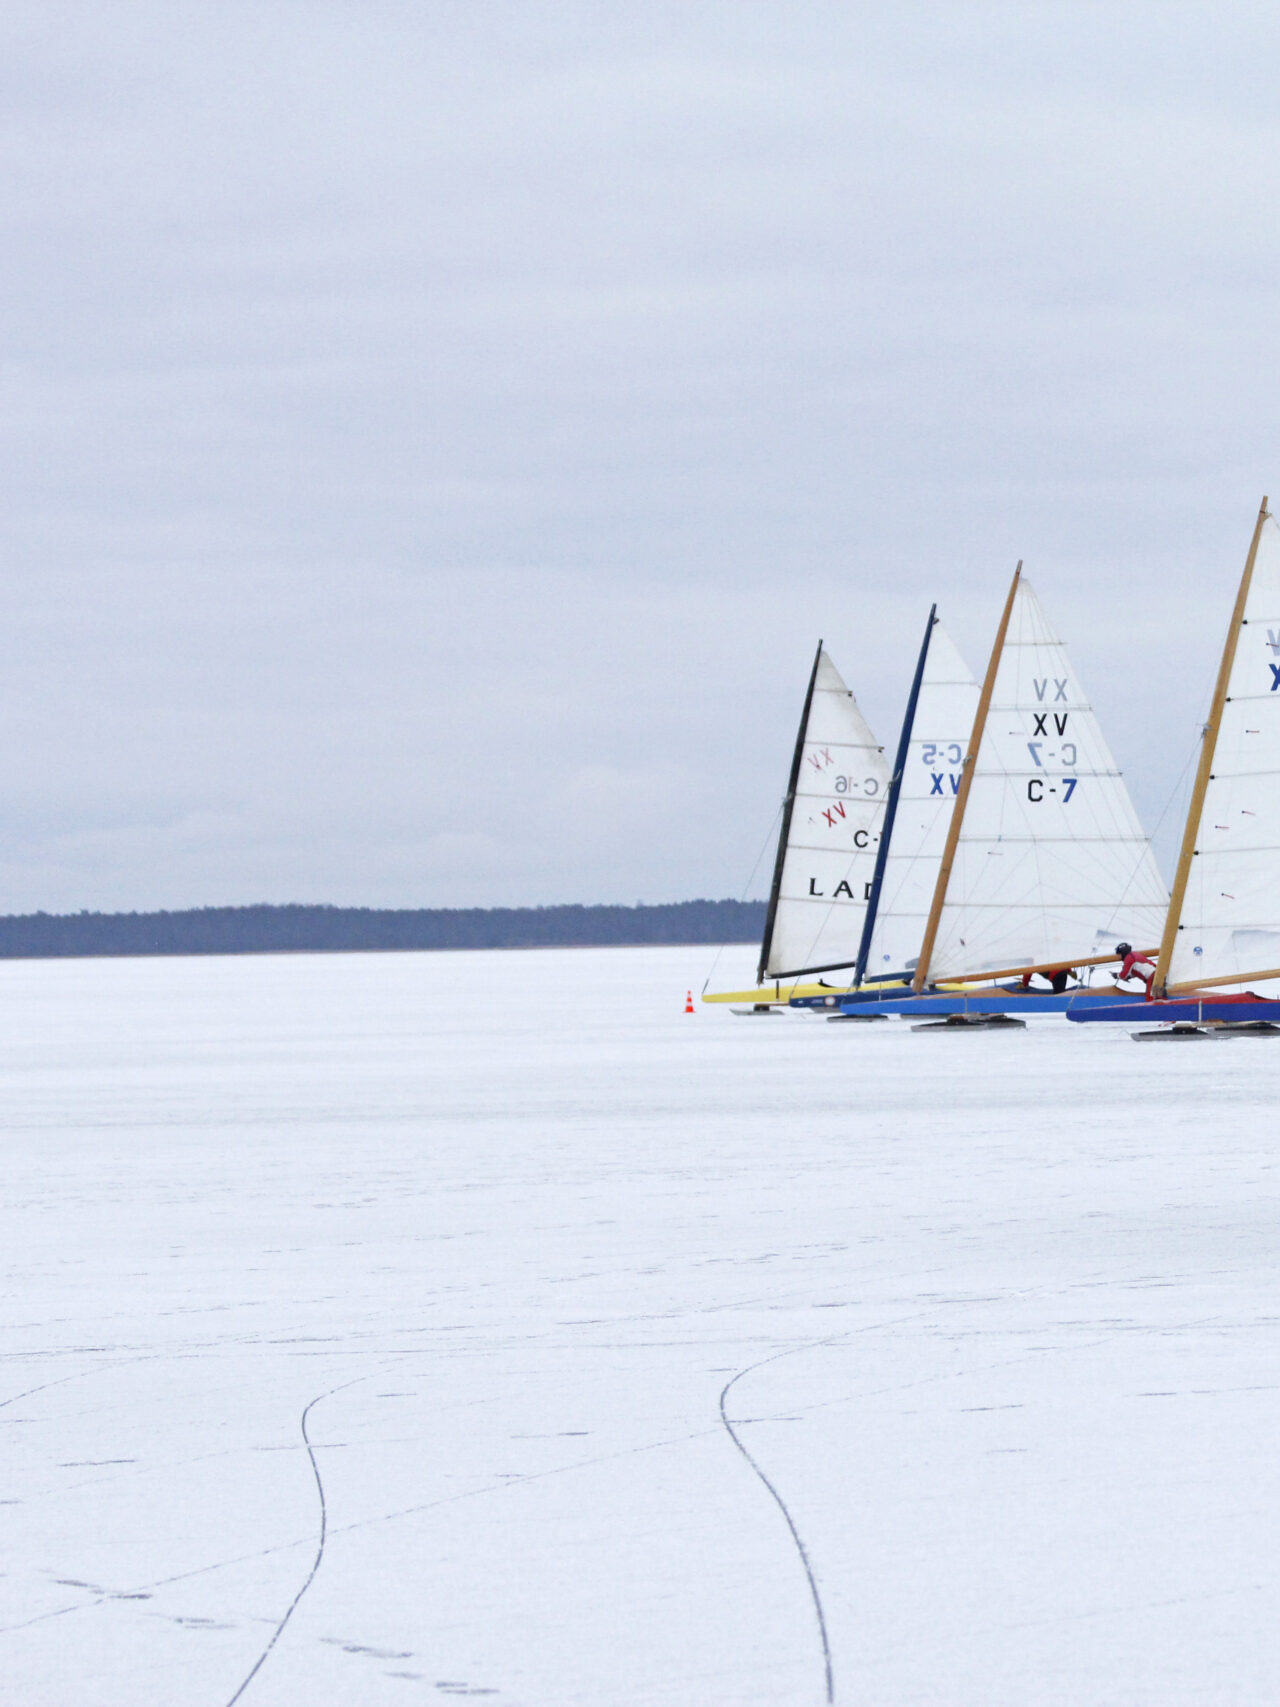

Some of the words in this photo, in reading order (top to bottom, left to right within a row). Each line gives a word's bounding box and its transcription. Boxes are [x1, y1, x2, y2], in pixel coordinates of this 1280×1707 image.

[1033, 713, 1068, 736] XV
[930, 773, 962, 795] XV
[1027, 778, 1078, 803] C-7
[821, 801, 846, 828] XV
[854, 830, 883, 848] C-
